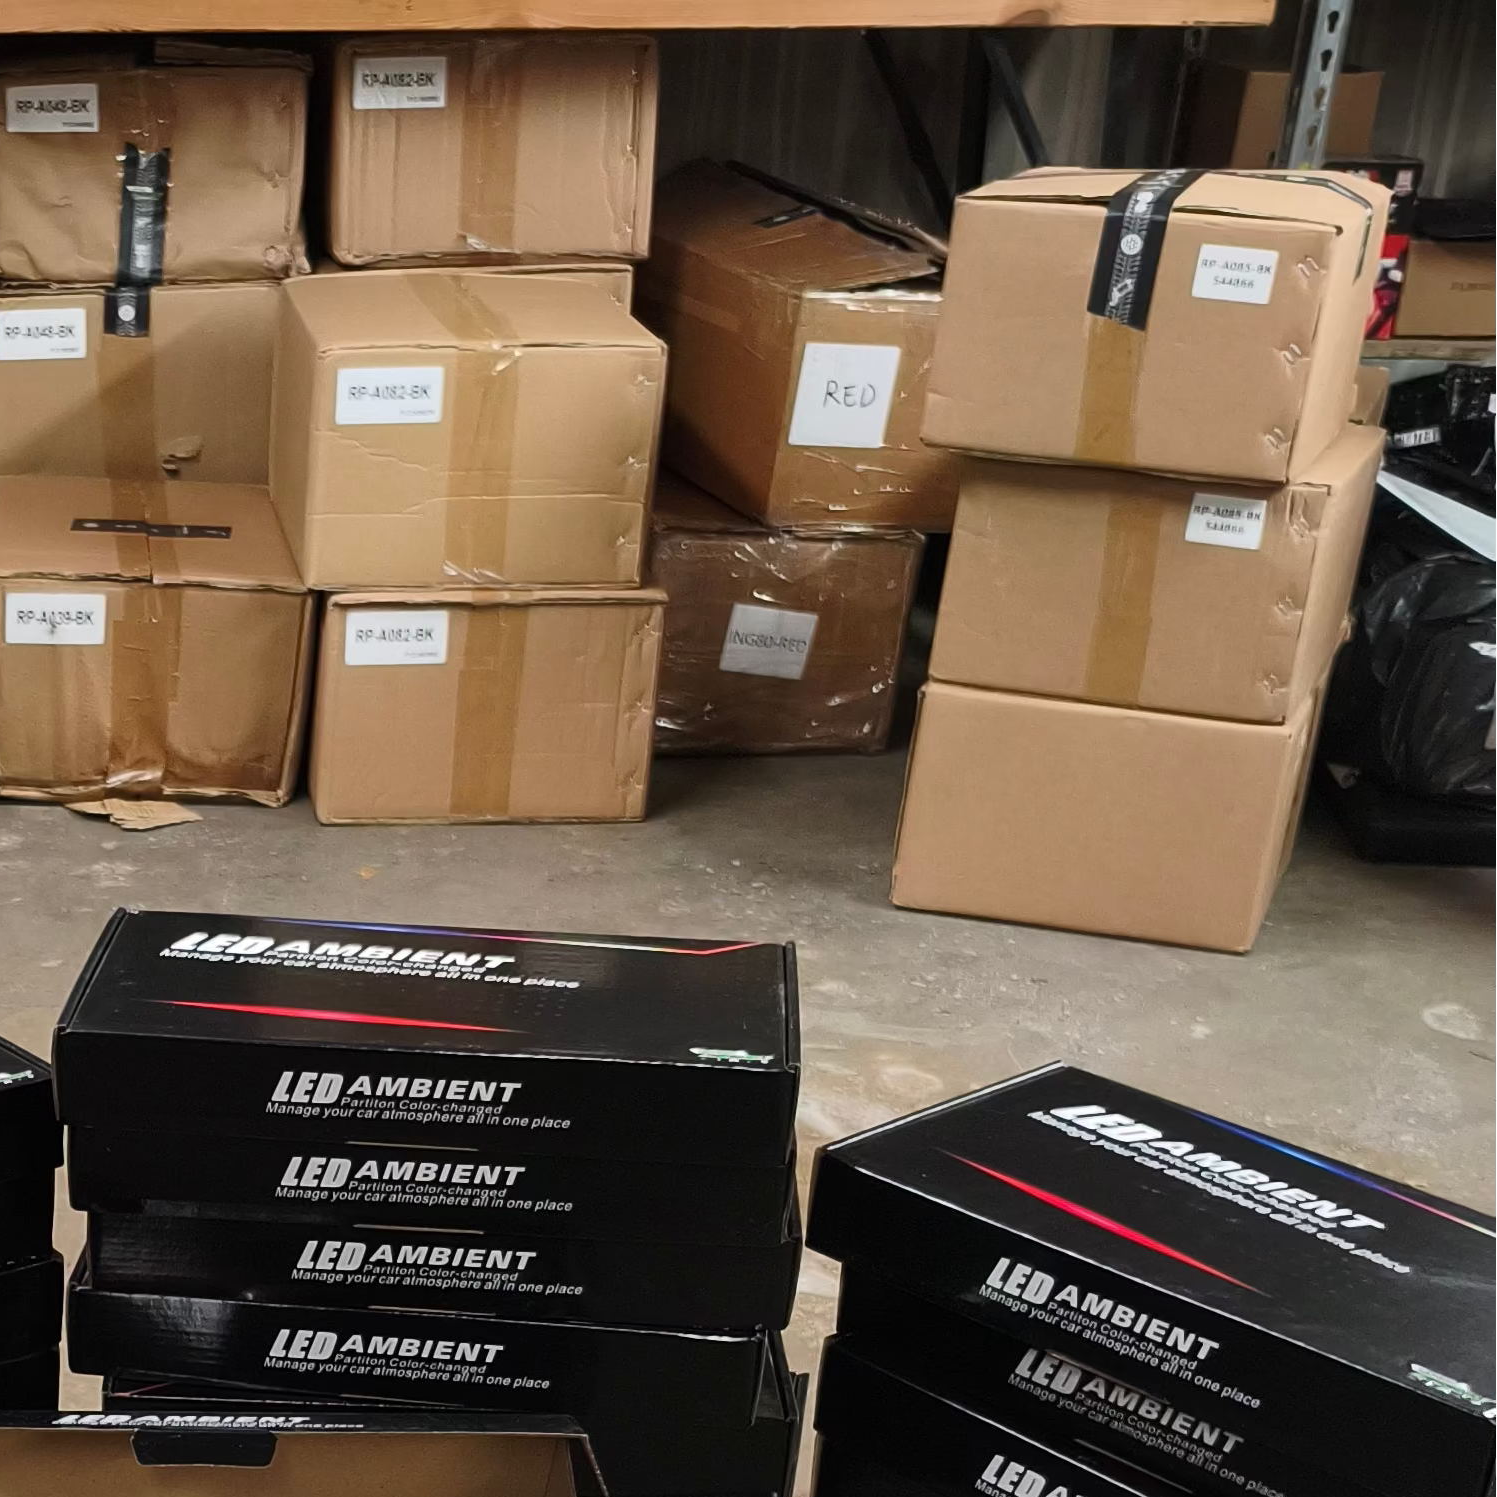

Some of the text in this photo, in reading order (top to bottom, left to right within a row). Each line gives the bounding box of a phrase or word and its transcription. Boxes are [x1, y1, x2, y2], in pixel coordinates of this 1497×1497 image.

[823, 380, 875, 408] RED
[170, 932, 516, 968] LED AMBIENT
[271, 1071, 522, 1104] LED AMBIENT
[265, 1102, 571, 1130] Manage your car atmosphere all in one place
[398, 1099, 503, 1117] Color-changed
[280, 1156, 526, 1188] LED AMBIENT
[1050, 1105, 1162, 1143] LED
[1147, 1141, 1386, 1229] AMBIENT
[296, 1240, 537, 1271] LED AMBIENT
[985, 1256, 1220, 1361] LED AMBIENT
[269, 1328, 505, 1363] LED AMBIENT
[979, 1284, 1260, 1409] Manage your car atmosphere all in one place
[1100, 1324, 1198, 1371] Color-changed
[263, 1356, 550, 1389] Manage your car atmosphere all in one place
[388, 1358, 487, 1375] Color-changed
[1014, 1347, 1245, 1455] LED AMBIENT
